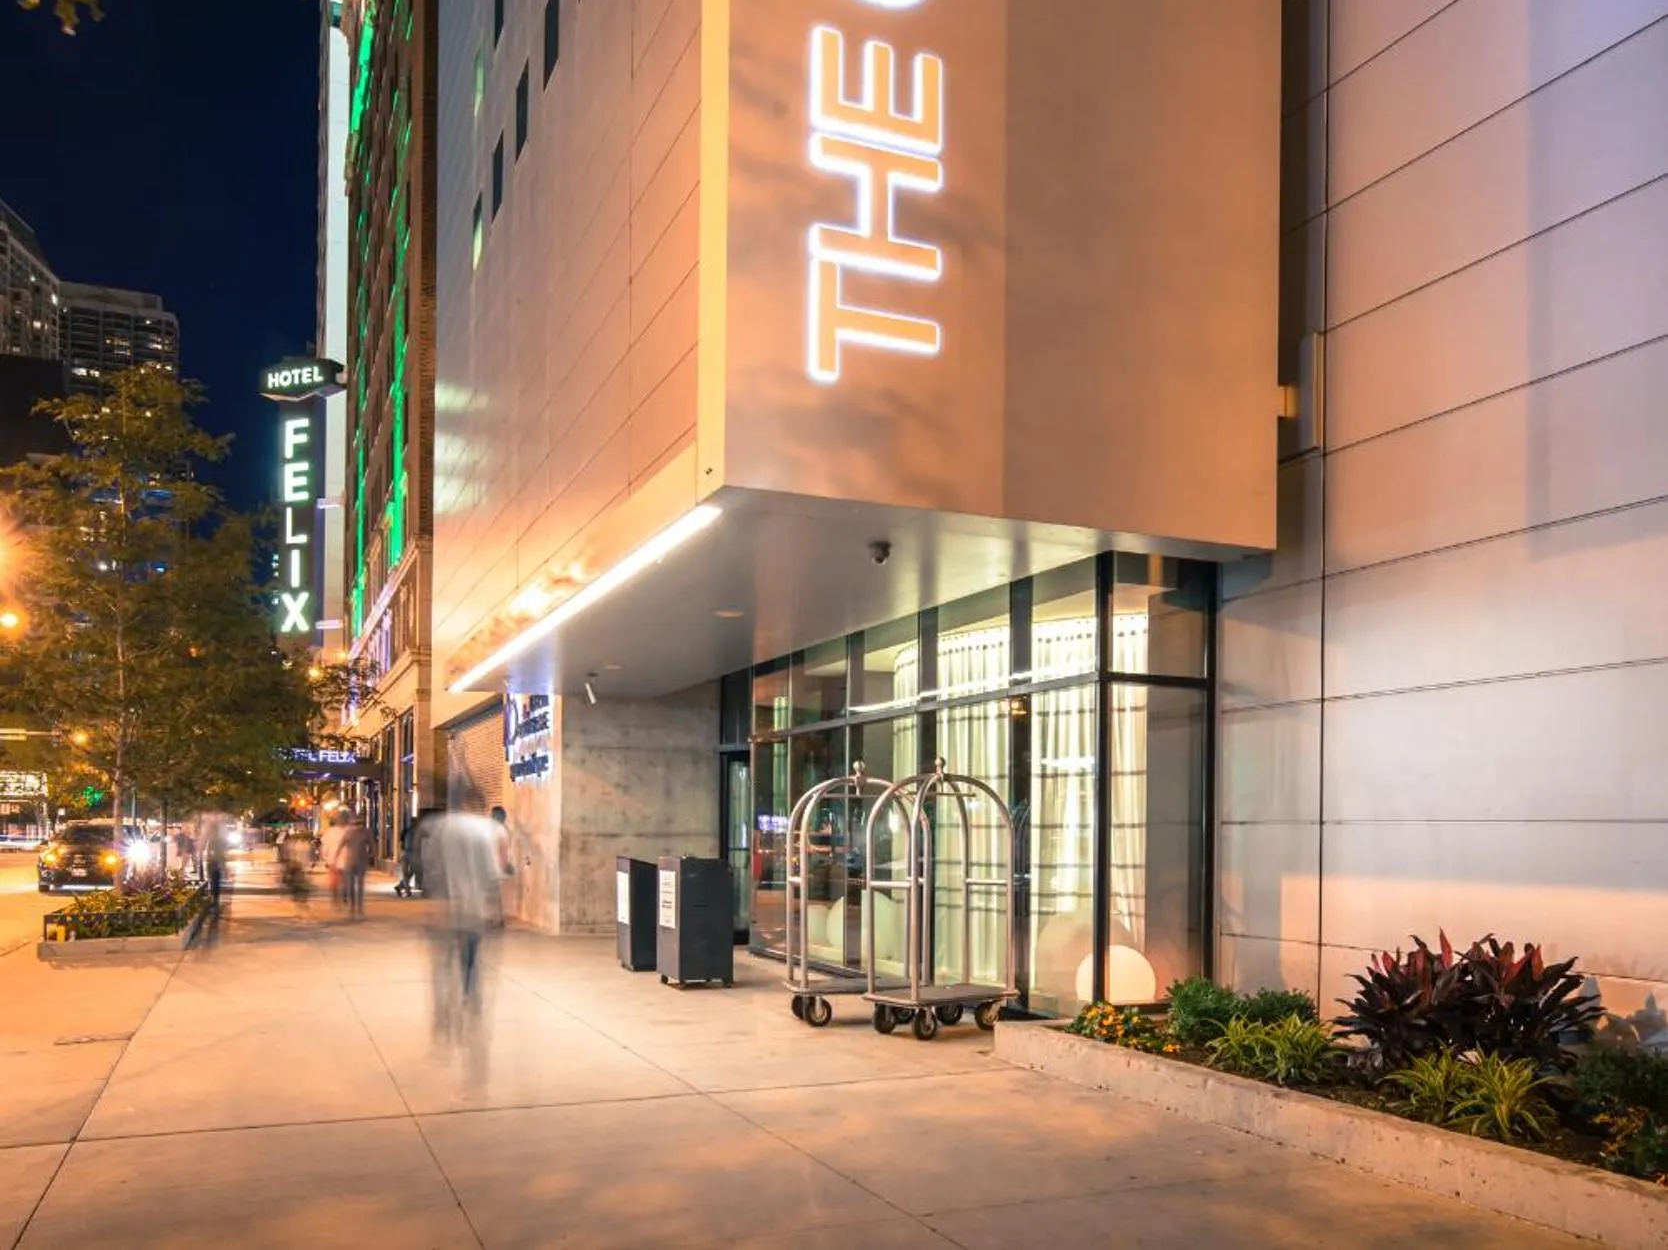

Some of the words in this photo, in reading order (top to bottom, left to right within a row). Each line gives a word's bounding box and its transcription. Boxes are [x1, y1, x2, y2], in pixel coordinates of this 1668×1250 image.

[810, 25, 943, 382] THE
[267, 366, 324, 389] HOTEL
[281, 417, 310, 633] FELIX
[319, 750, 356, 763] FELIX
